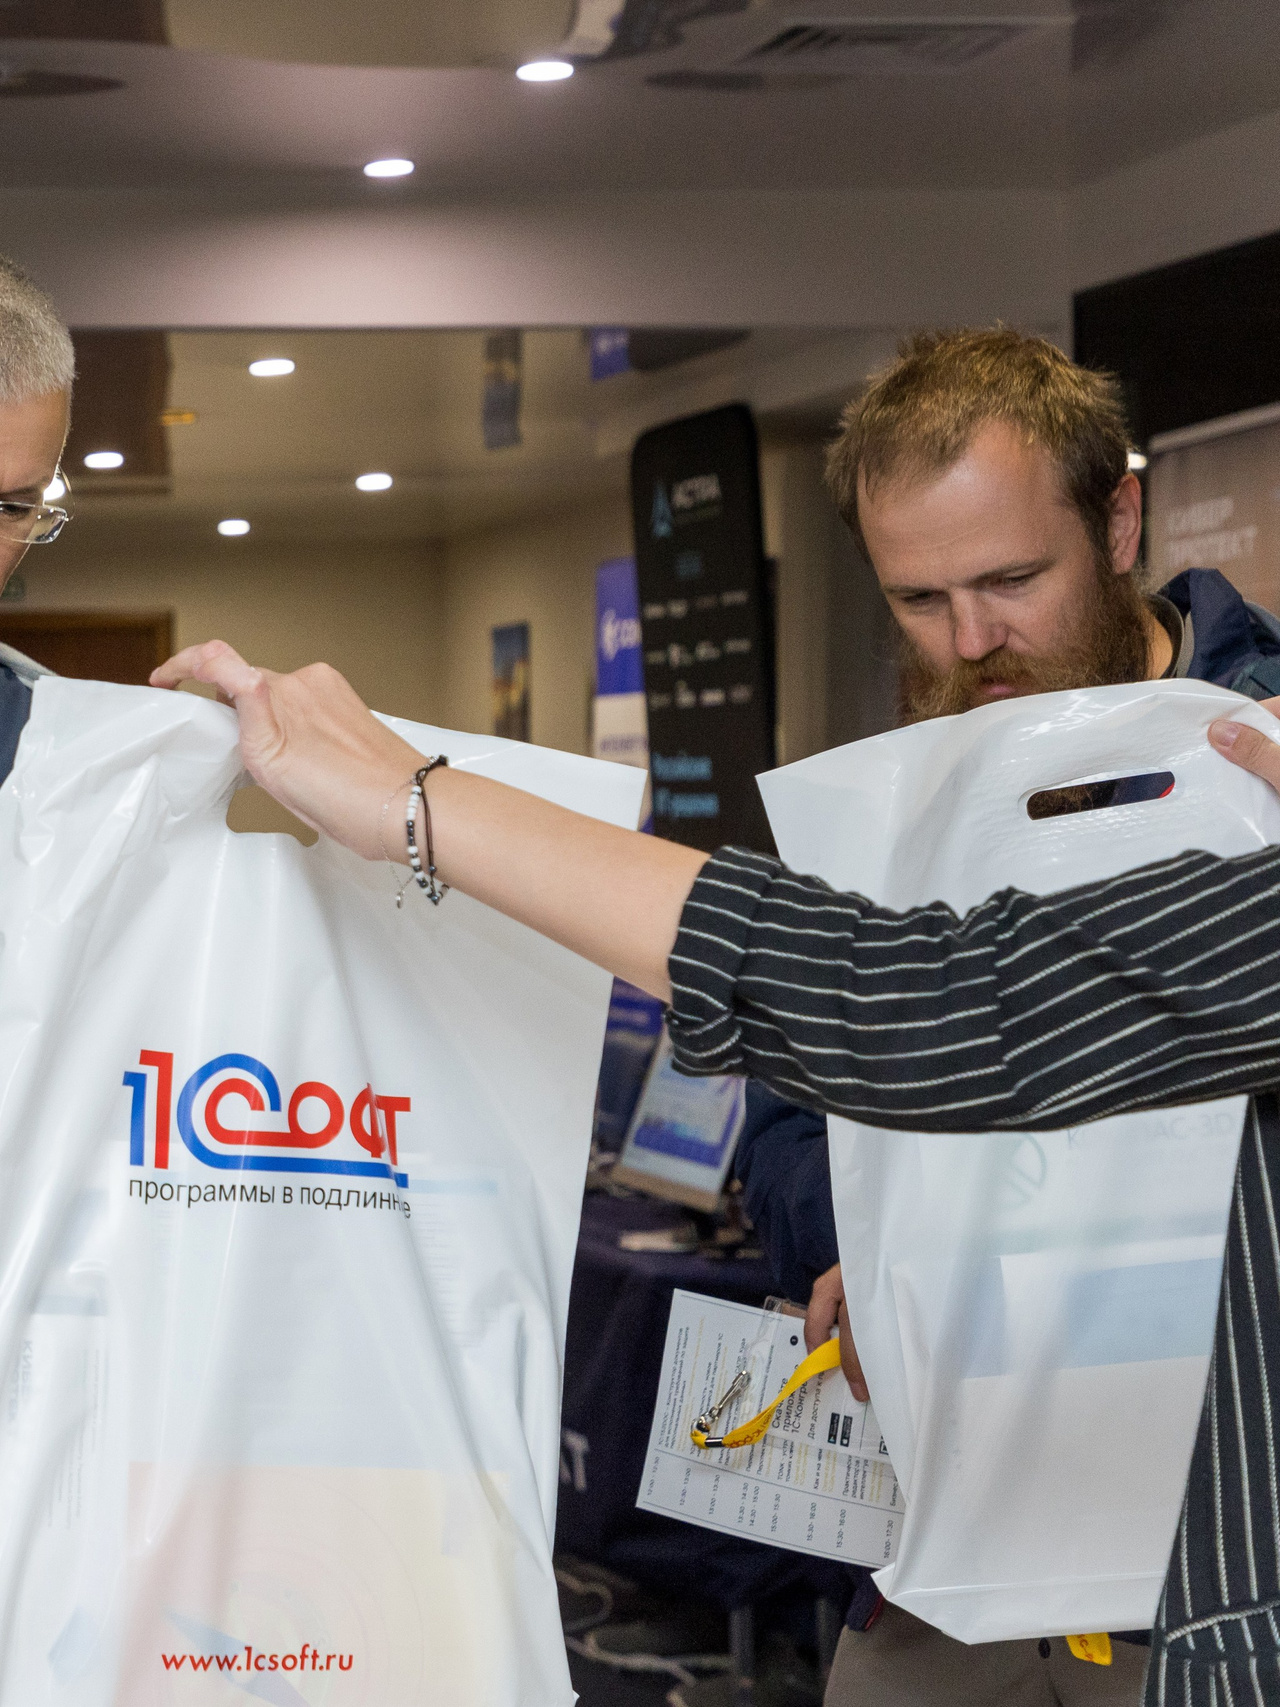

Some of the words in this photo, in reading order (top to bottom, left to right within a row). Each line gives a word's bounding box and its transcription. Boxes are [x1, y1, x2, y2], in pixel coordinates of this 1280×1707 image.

[129, 1179, 275, 1209] программы
[283, 1186, 293, 1204] в
[809, 1387, 823, 1422] доступа
[806, 1423, 816, 1439] Для
[161, 1643, 354, 1671] www.1csoft.ru
